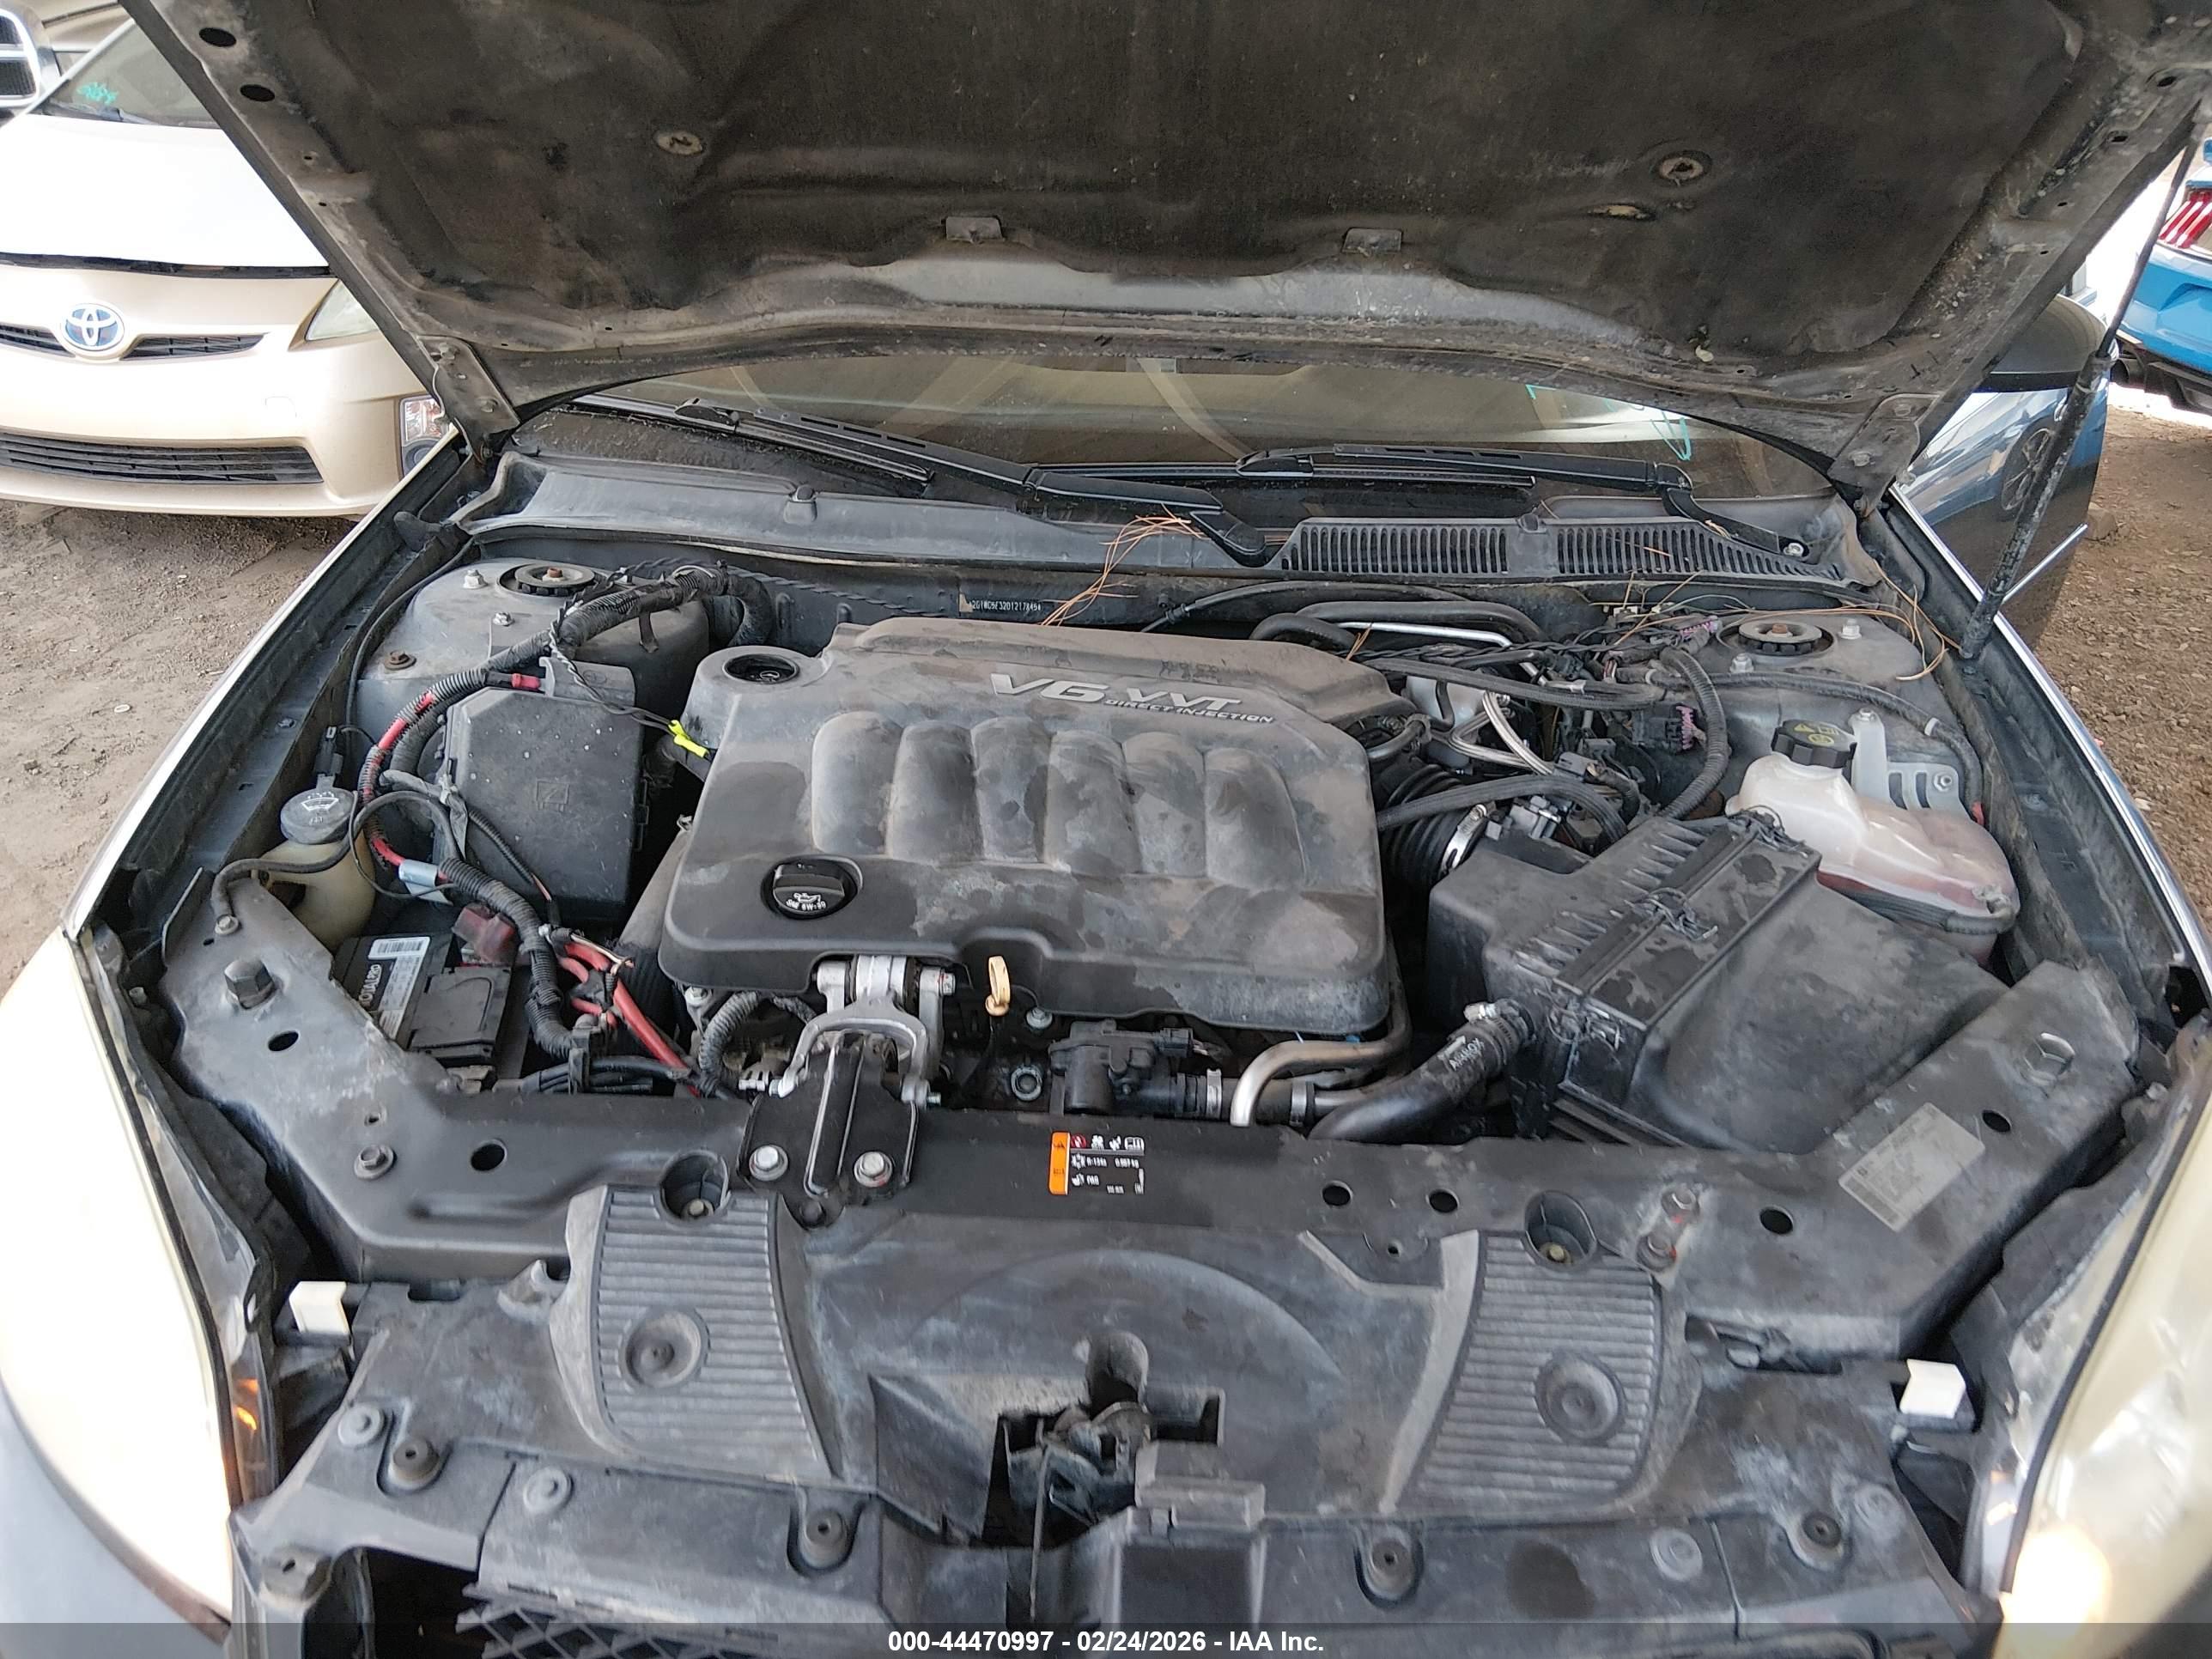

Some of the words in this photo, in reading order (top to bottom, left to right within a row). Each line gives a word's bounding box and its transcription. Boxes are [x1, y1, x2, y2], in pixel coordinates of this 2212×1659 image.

[990, 672, 1109, 703] V6
[1126, 687, 1242, 711] VVT
[1104, 698, 1174, 714] DIRECT
[1175, 706, 1274, 724] INJECTION
